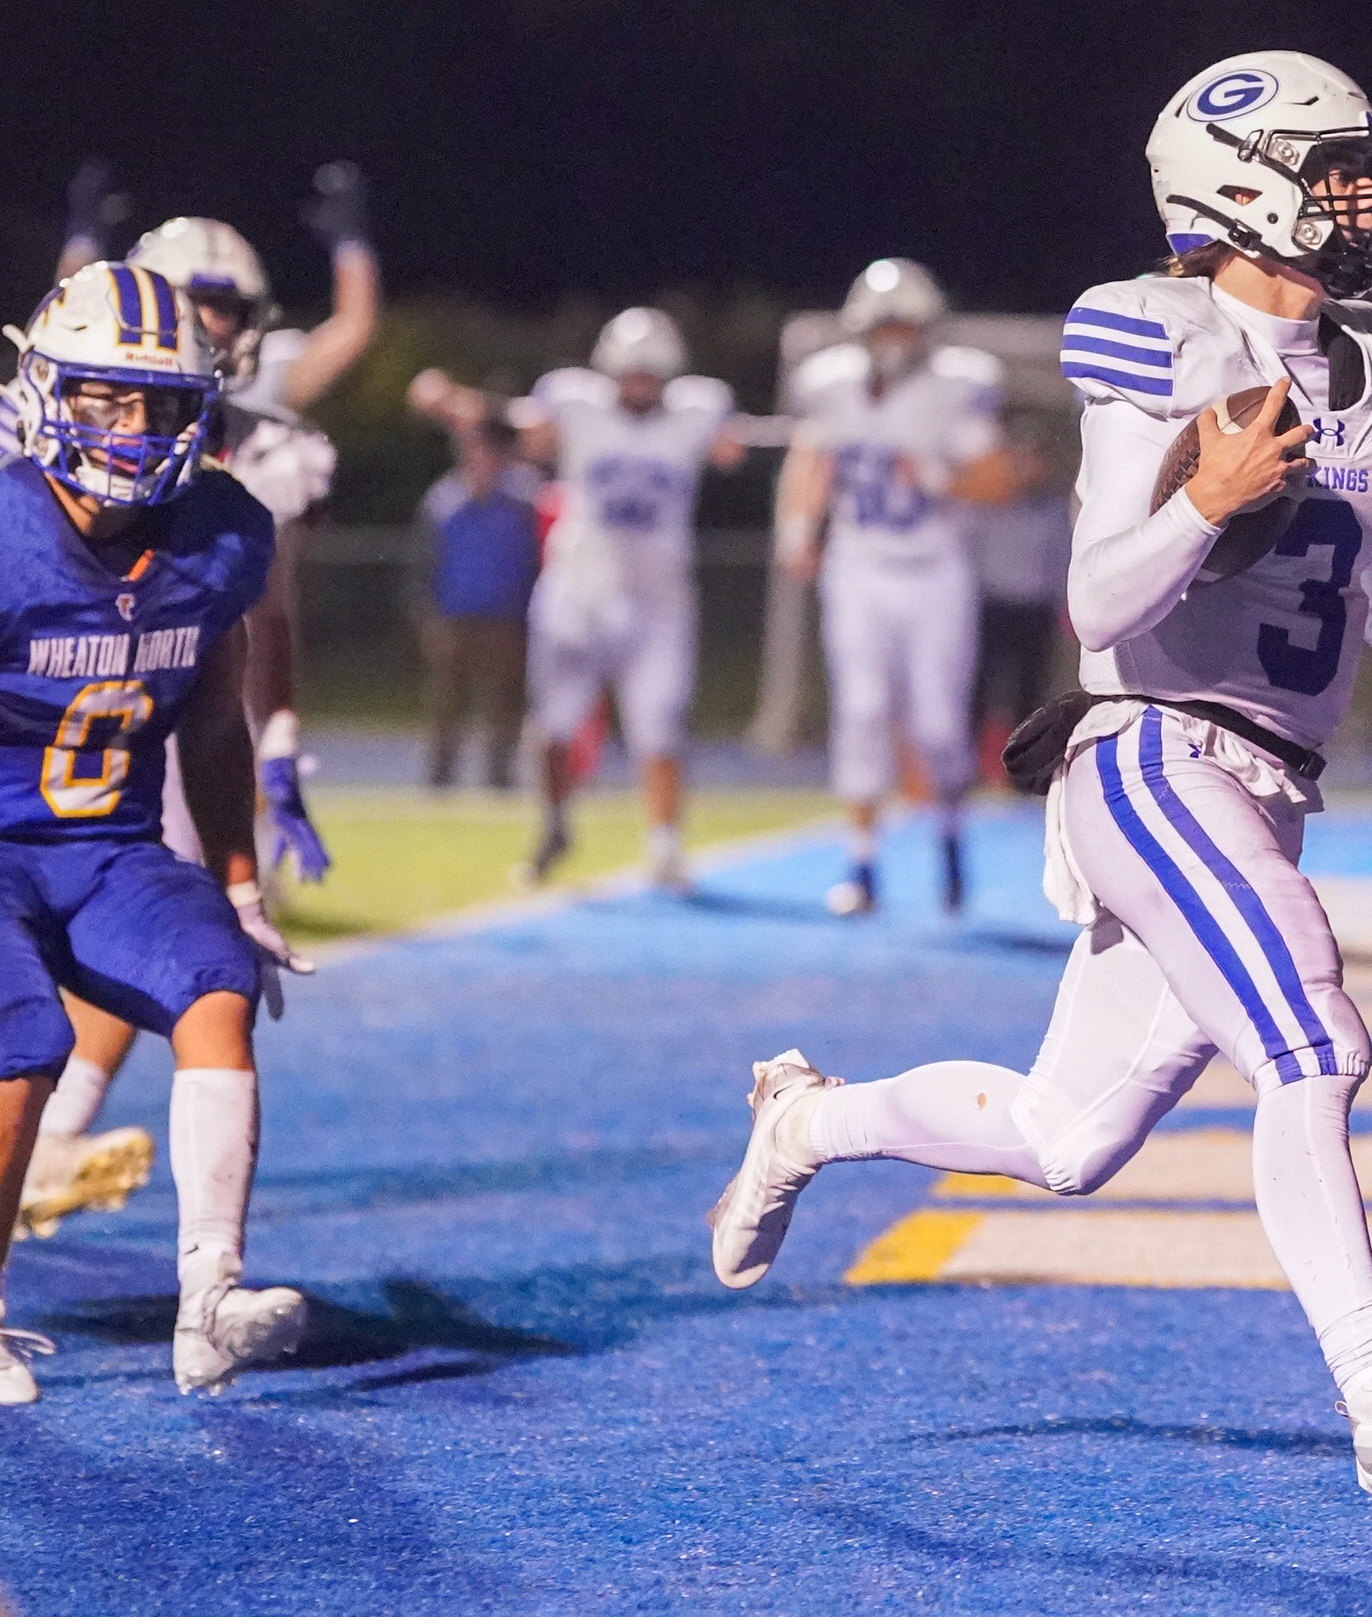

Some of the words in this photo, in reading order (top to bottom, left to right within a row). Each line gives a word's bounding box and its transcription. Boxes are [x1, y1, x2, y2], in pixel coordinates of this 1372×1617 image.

[1197, 73, 1265, 116] G
[1307, 466, 1369, 493] KINGS
[1257, 499, 1363, 697] 3
[27, 633, 130, 678] WHEATON
[133, 626, 200, 672] NORTH
[40, 680, 154, 818] 0
